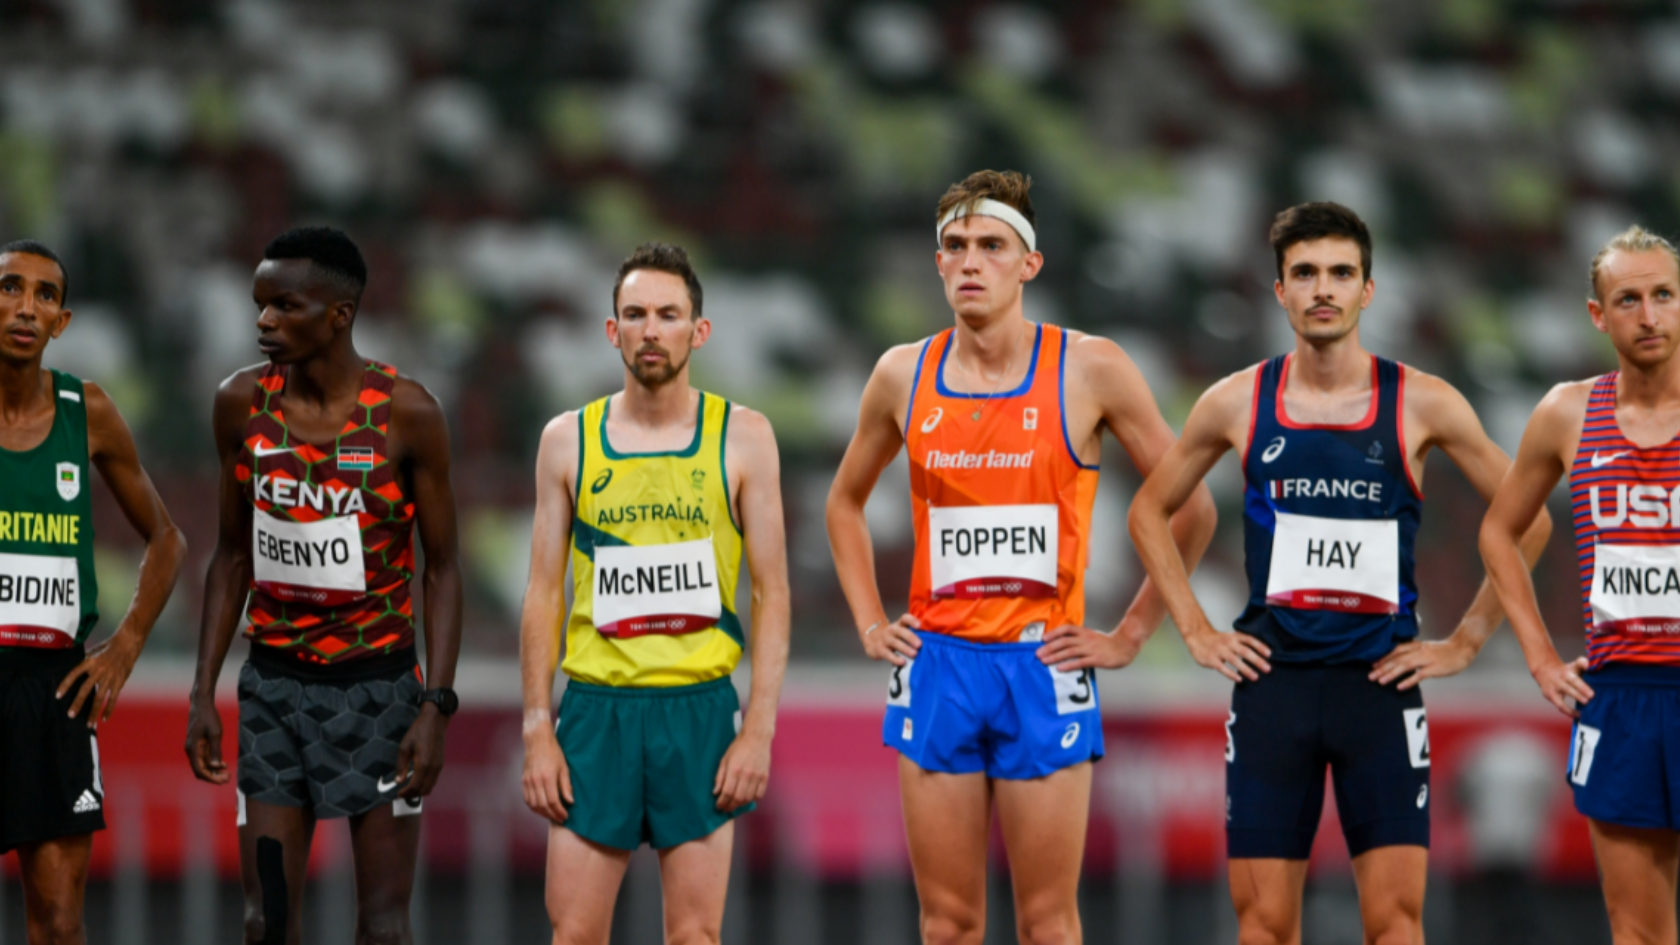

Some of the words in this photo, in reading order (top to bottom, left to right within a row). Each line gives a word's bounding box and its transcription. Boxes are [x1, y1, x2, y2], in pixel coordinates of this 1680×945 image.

[925, 449, 1035, 470] Nederland
[253, 473, 367, 514] KENYA
[1283, 478, 1382, 502] FRANCE
[0, 510, 80, 545] RITANIE
[597, 503, 704, 527] AUSTRALIA
[258, 529, 349, 567] EBENYO
[941, 526, 1046, 557] FOPPEN
[1306, 538, 1362, 569] HAY
[0, 574, 75, 606] BIDINE
[599, 561, 712, 596] McNEILL
[1602, 566, 1680, 595] KINCA
